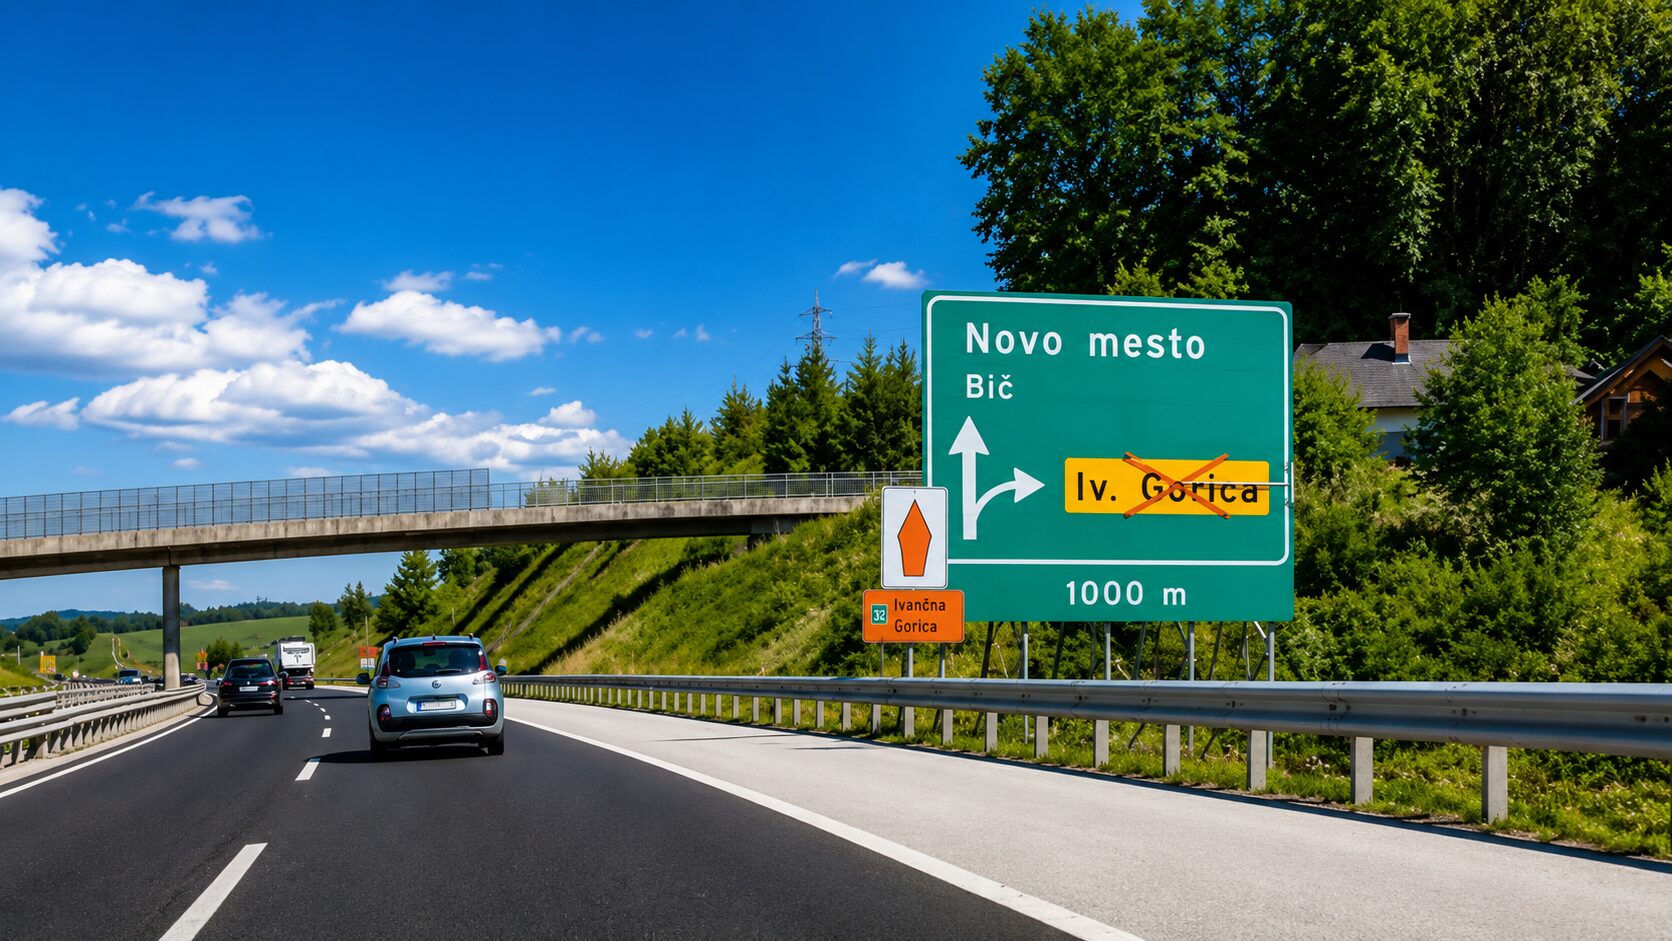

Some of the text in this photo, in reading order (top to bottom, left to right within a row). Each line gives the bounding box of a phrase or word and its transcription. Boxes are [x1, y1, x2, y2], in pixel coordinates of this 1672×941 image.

[966, 322, 1205, 360] Novo mesto
[966, 373, 1014, 400] Bič
[1077, 471, 1258, 503] Iv. Gorica
[894, 598, 946, 612] Ivančna
[1066, 580, 1186, 606] 1000 m
[894, 619, 937, 633] Gorica
